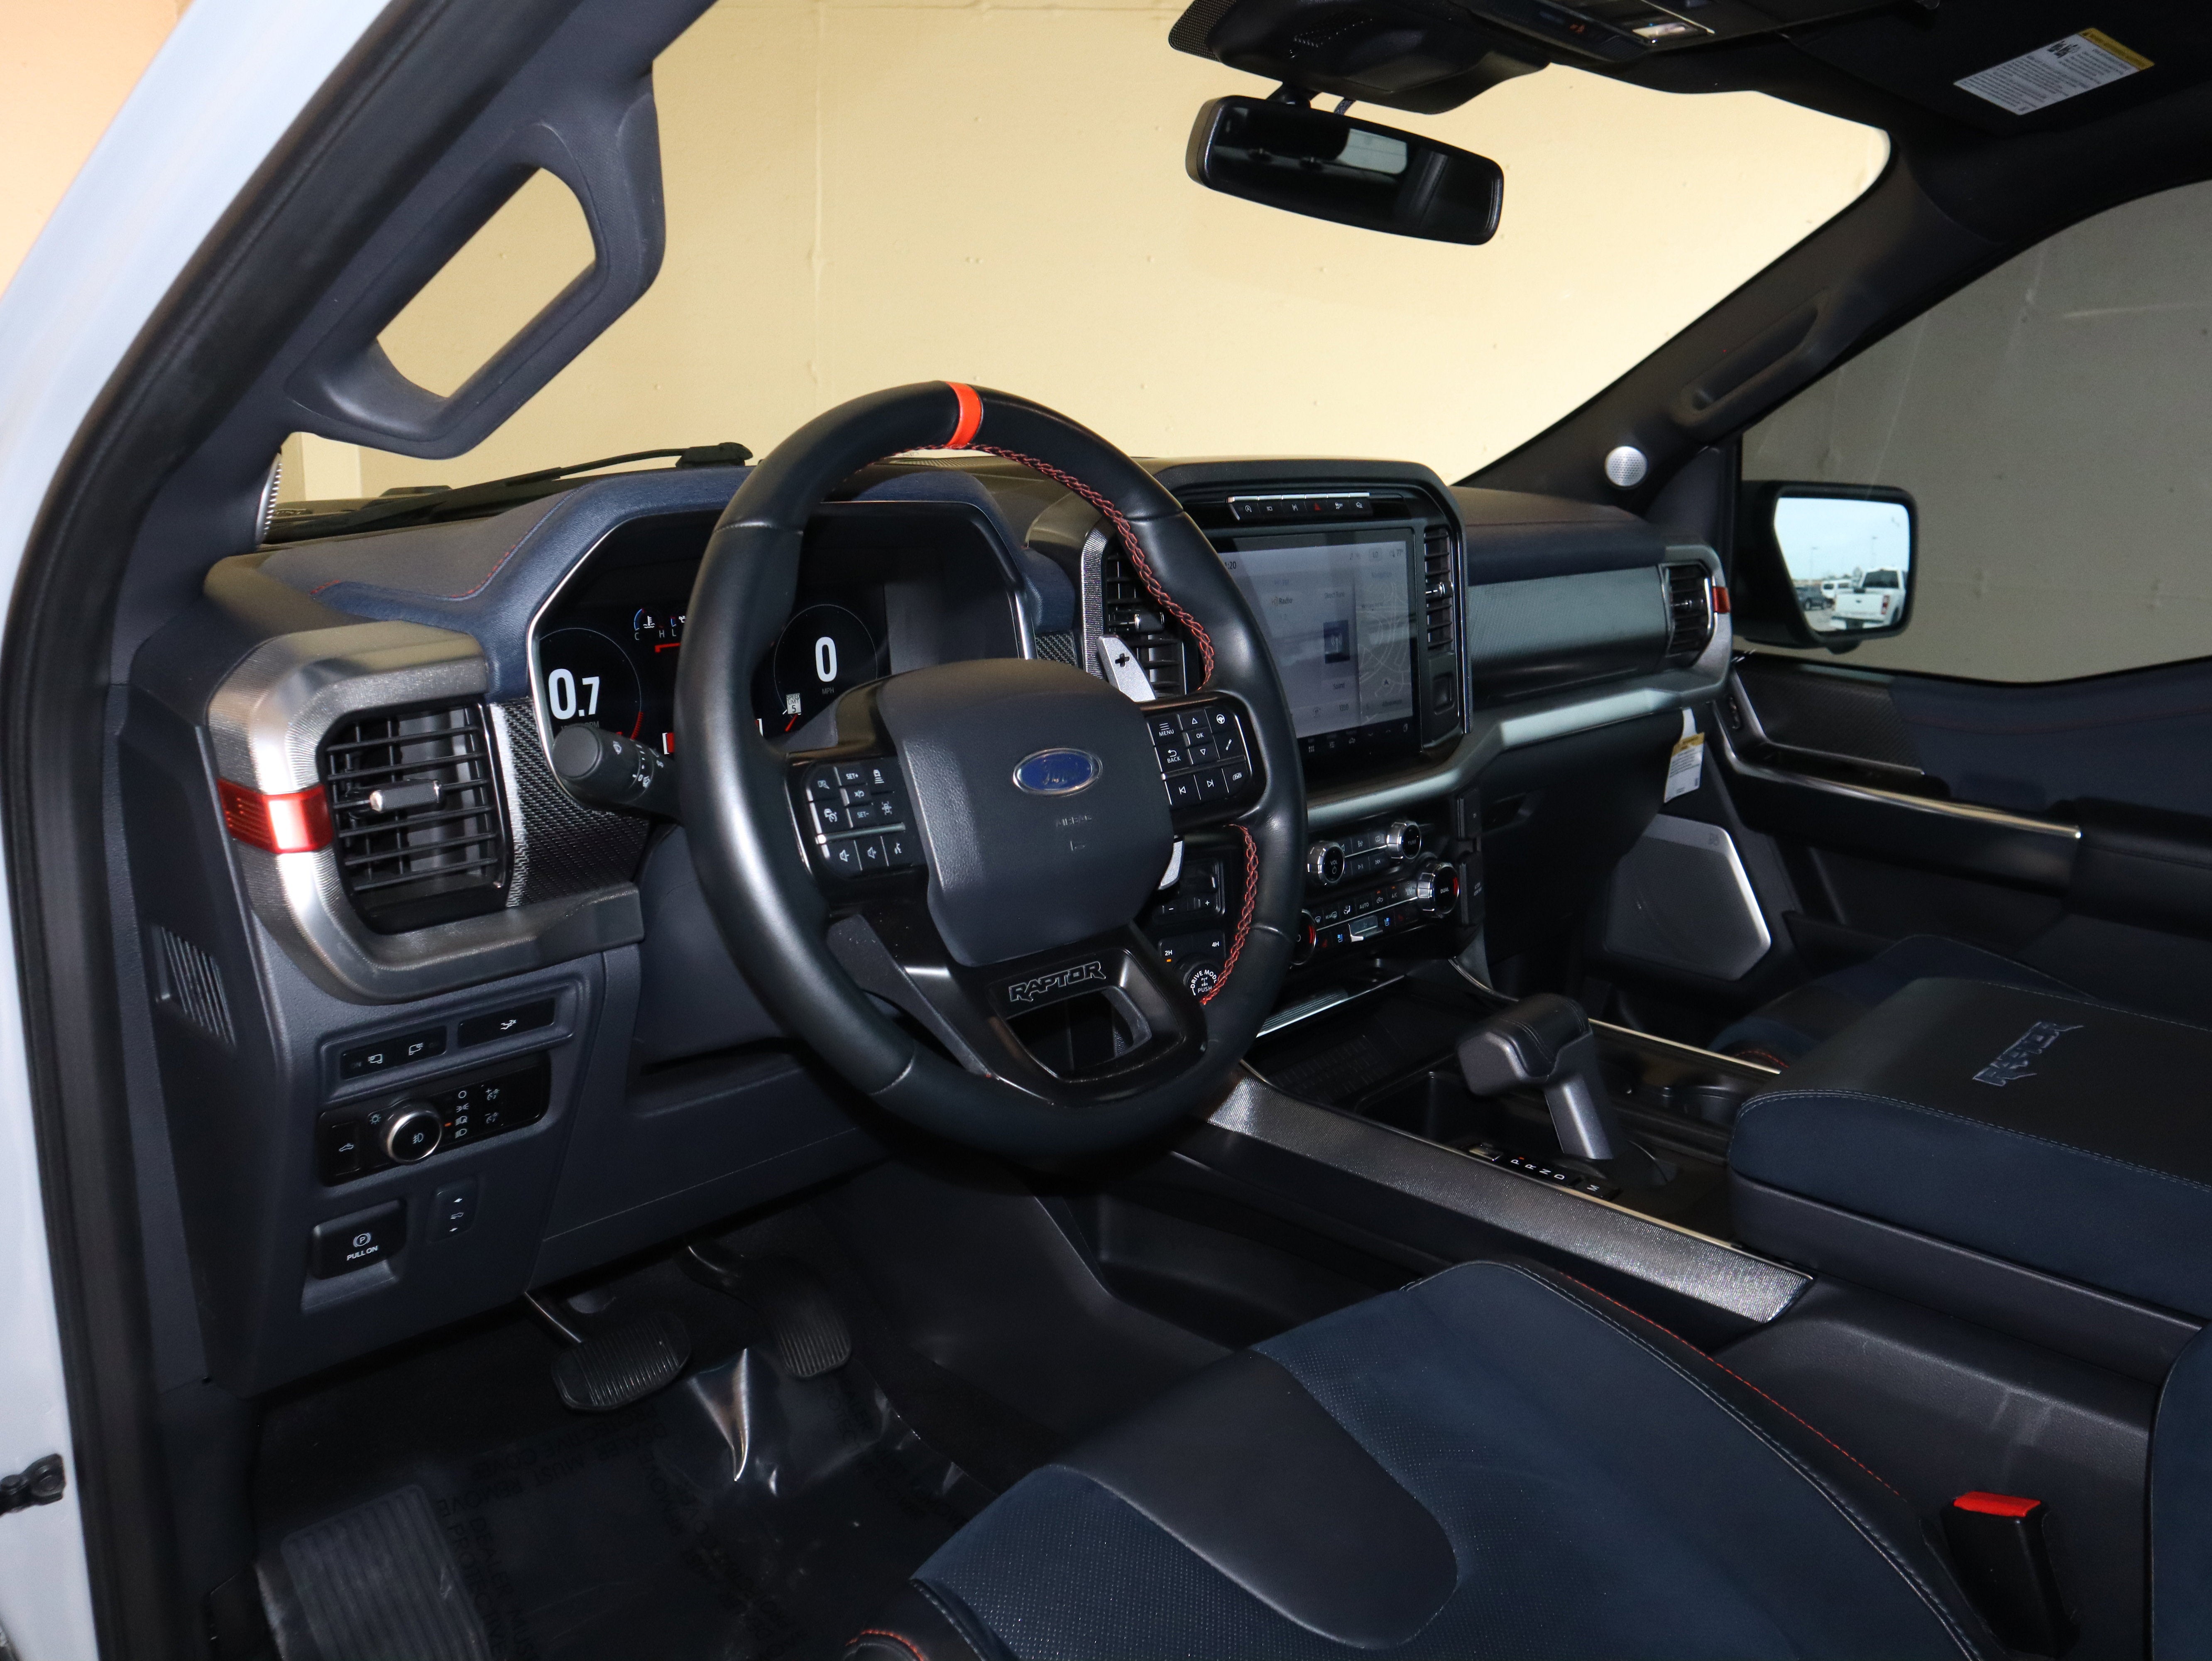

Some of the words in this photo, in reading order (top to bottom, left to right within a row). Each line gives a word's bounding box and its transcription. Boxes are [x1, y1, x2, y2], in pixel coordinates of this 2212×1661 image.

[634, 632, 640, 641] C
[659, 630, 665, 638] H
[815, 636, 837, 682] 0
[548, 668, 600, 720] 0.7
[791, 705, 796, 713] 5
[1159, 729, 1174, 737] MENU
[1167, 755, 1181, 764] BACK
[1008, 960, 1107, 1002] RAPTOR
[1190, 970, 1203, 988] DRIVE
[346, 1250, 365, 1261] PULL
[366, 1245, 378, 1254] ON
[467, 1515, 514, 1598] DEALER
